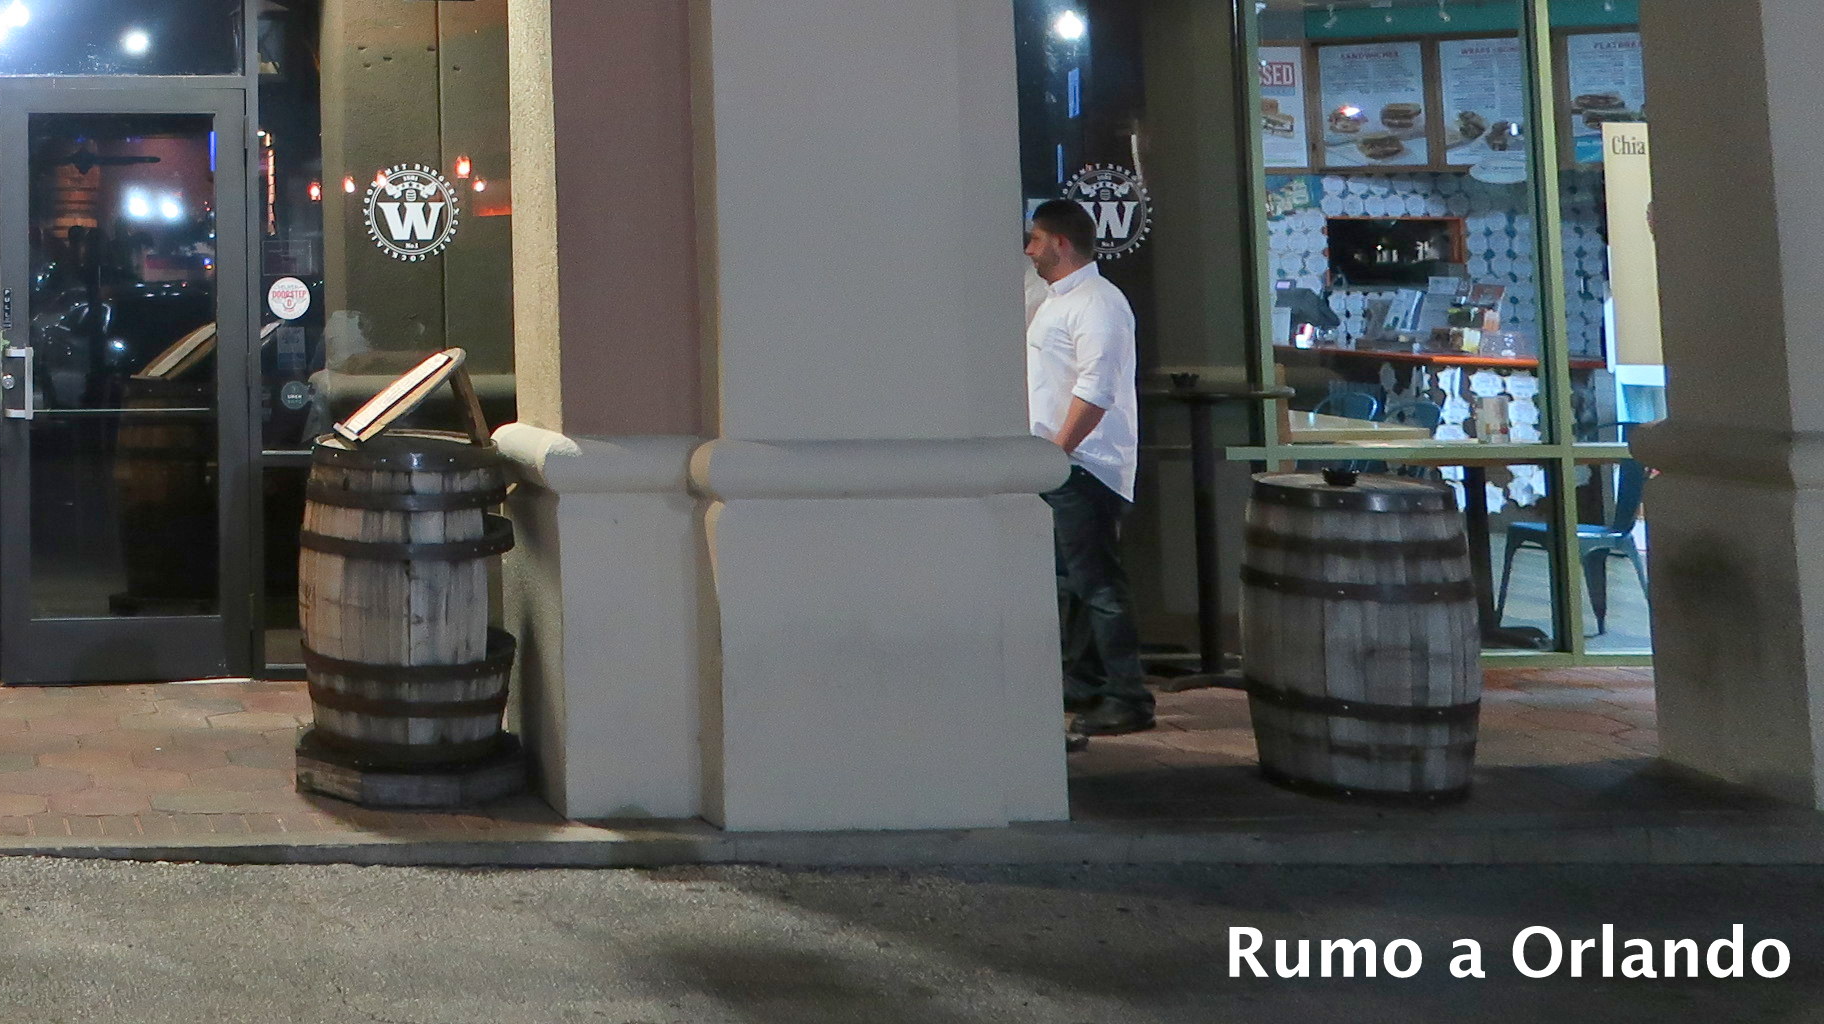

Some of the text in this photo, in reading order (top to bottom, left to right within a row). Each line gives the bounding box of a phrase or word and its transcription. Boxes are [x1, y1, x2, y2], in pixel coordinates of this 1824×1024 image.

[1611, 135, 1647, 156] Chia
[363, 163, 408, 204] GOUMET
[376, 202, 446, 241] W
